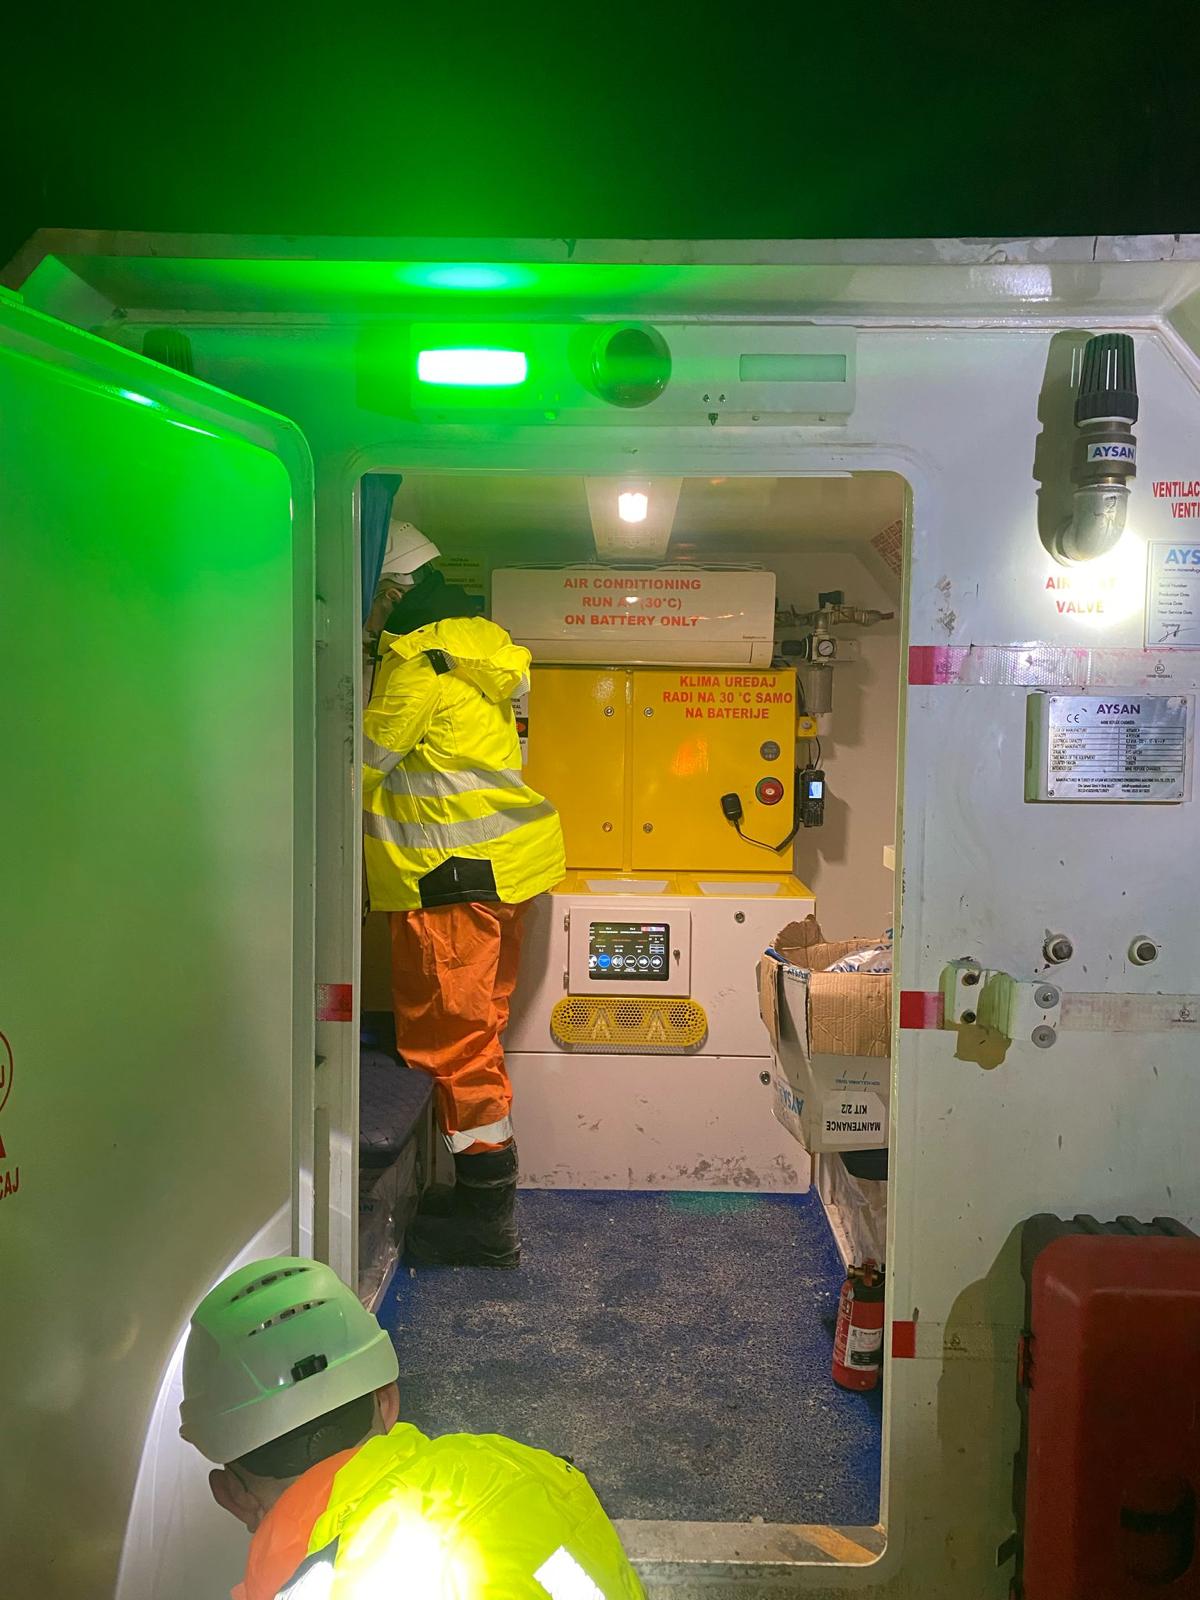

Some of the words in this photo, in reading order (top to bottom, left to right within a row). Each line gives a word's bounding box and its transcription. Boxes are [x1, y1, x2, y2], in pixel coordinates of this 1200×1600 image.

[1092, 446, 1134, 459] AYSAN
[564, 578, 588, 589] AIR
[593, 578, 702, 590] CONDITIONING
[1045, 576, 1071, 590] AIR
[582, 596, 612, 608] RUN
[617, 597, 632, 608] A
[1056, 600, 1104, 614] VALVE
[564, 614, 586, 625] ON
[590, 615, 655, 626] BATTERY
[660, 615, 699, 627] ONLY
[680, 676, 720, 687] KLIMA
[725, 676, 776, 688] UREĐAJ
[662, 691, 693, 703] RADI
[698, 692, 716, 703] NA
[720, 692, 734, 704] 30
[756, 692, 793, 704] SAMO
[686, 707, 703, 719] NA
[708, 708, 769, 720] BATERIJE
[1096, 704, 1141, 714] AYSAN
[841, 1104, 853, 1114] 2/2
[854, 1104, 868, 1114] KIT
[826, 1120, 881, 1132] MAINTENANCE
